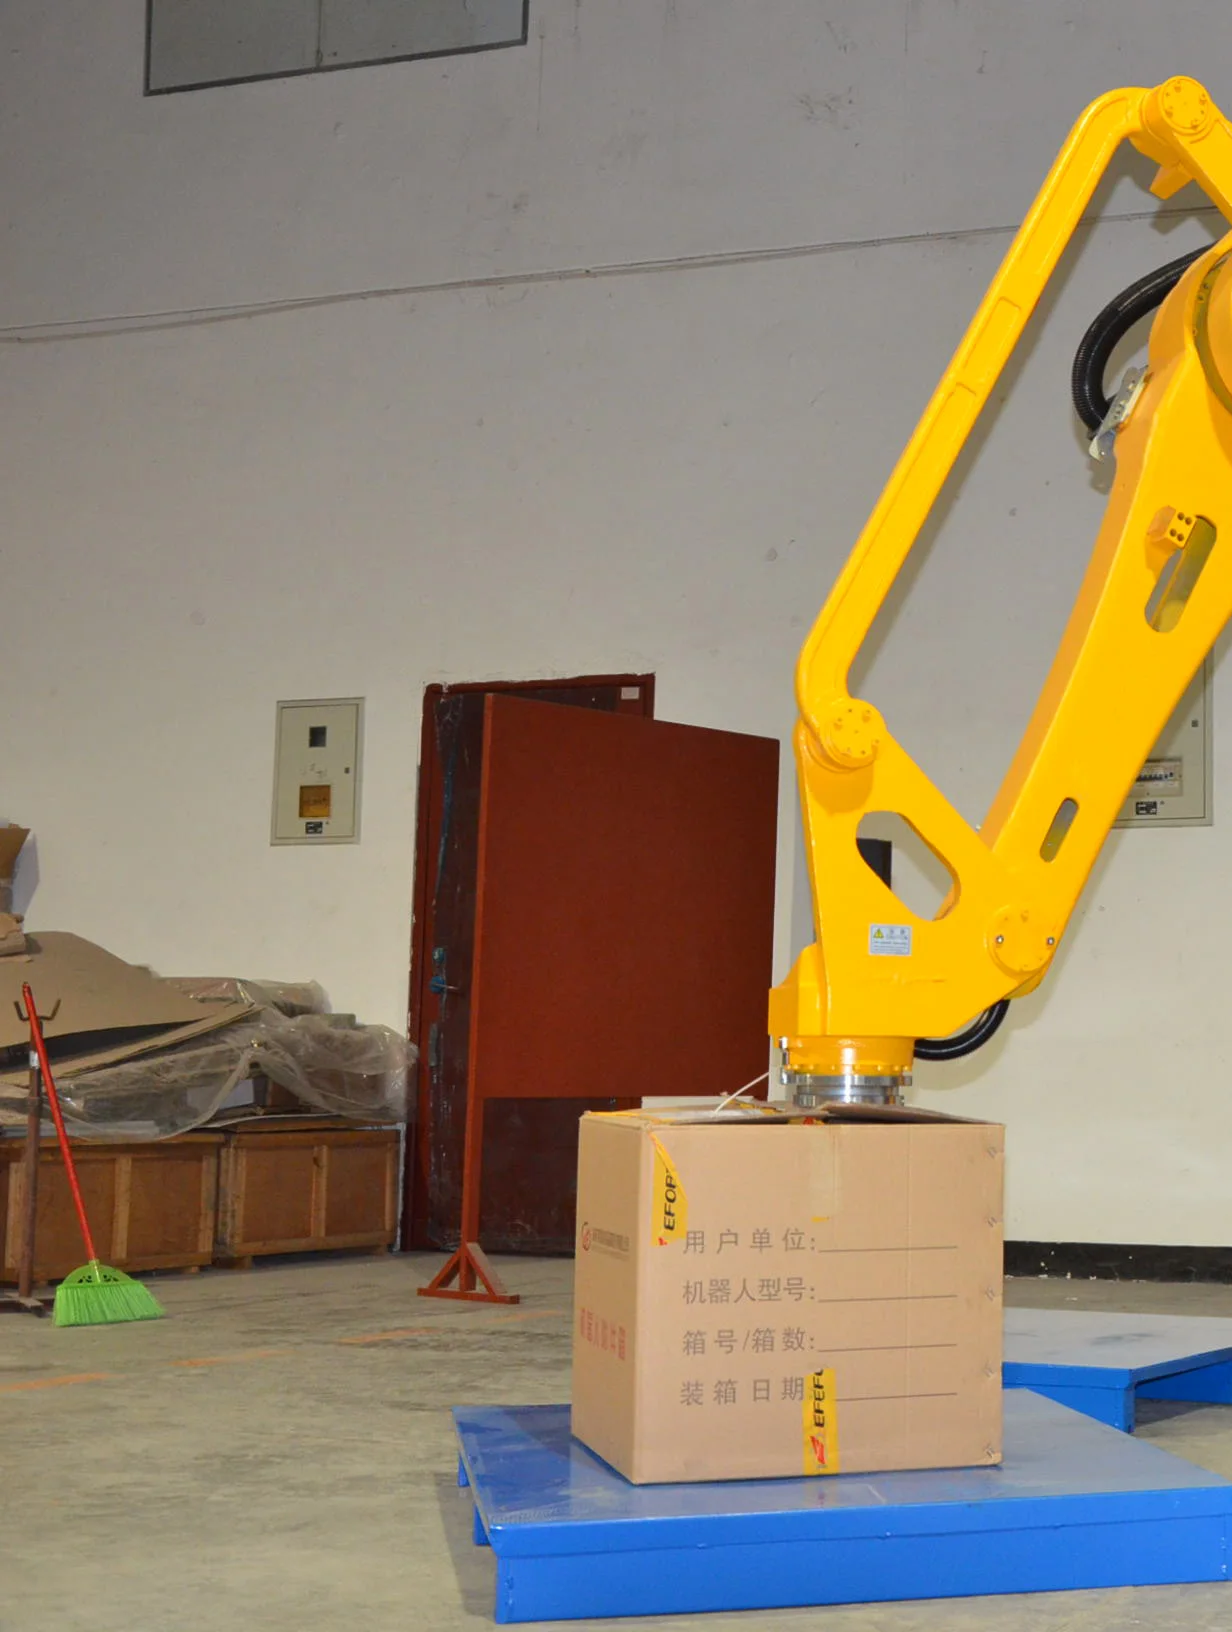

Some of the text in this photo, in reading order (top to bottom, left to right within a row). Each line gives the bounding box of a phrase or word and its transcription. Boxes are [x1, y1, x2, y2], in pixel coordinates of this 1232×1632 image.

[682, 1277, 815, 1305] 机器人型号:
